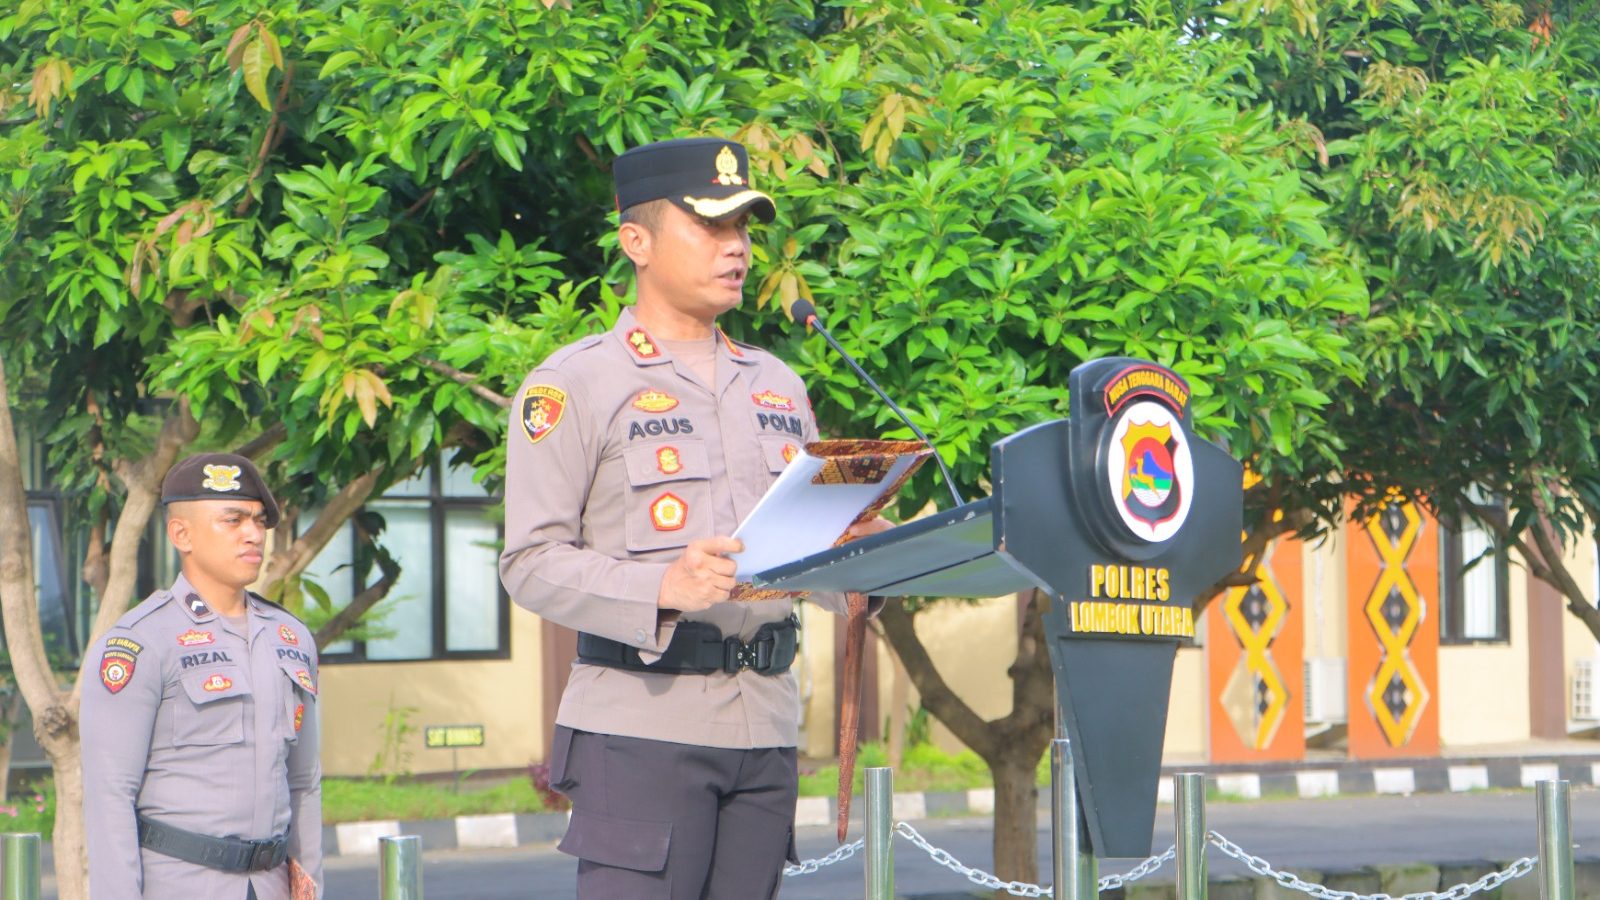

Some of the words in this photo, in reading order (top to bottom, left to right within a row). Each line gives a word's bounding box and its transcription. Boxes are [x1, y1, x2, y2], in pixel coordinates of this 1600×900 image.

[628, 417, 694, 440] AGUS
[756, 412, 803, 437] POLRI
[1091, 564, 1170, 601] POLRES
[1070, 601, 1140, 634] LOMBOK
[1141, 604, 1195, 637] UTARA
[180, 651, 232, 669] RIZAL
[276, 648, 311, 667] POLRI
